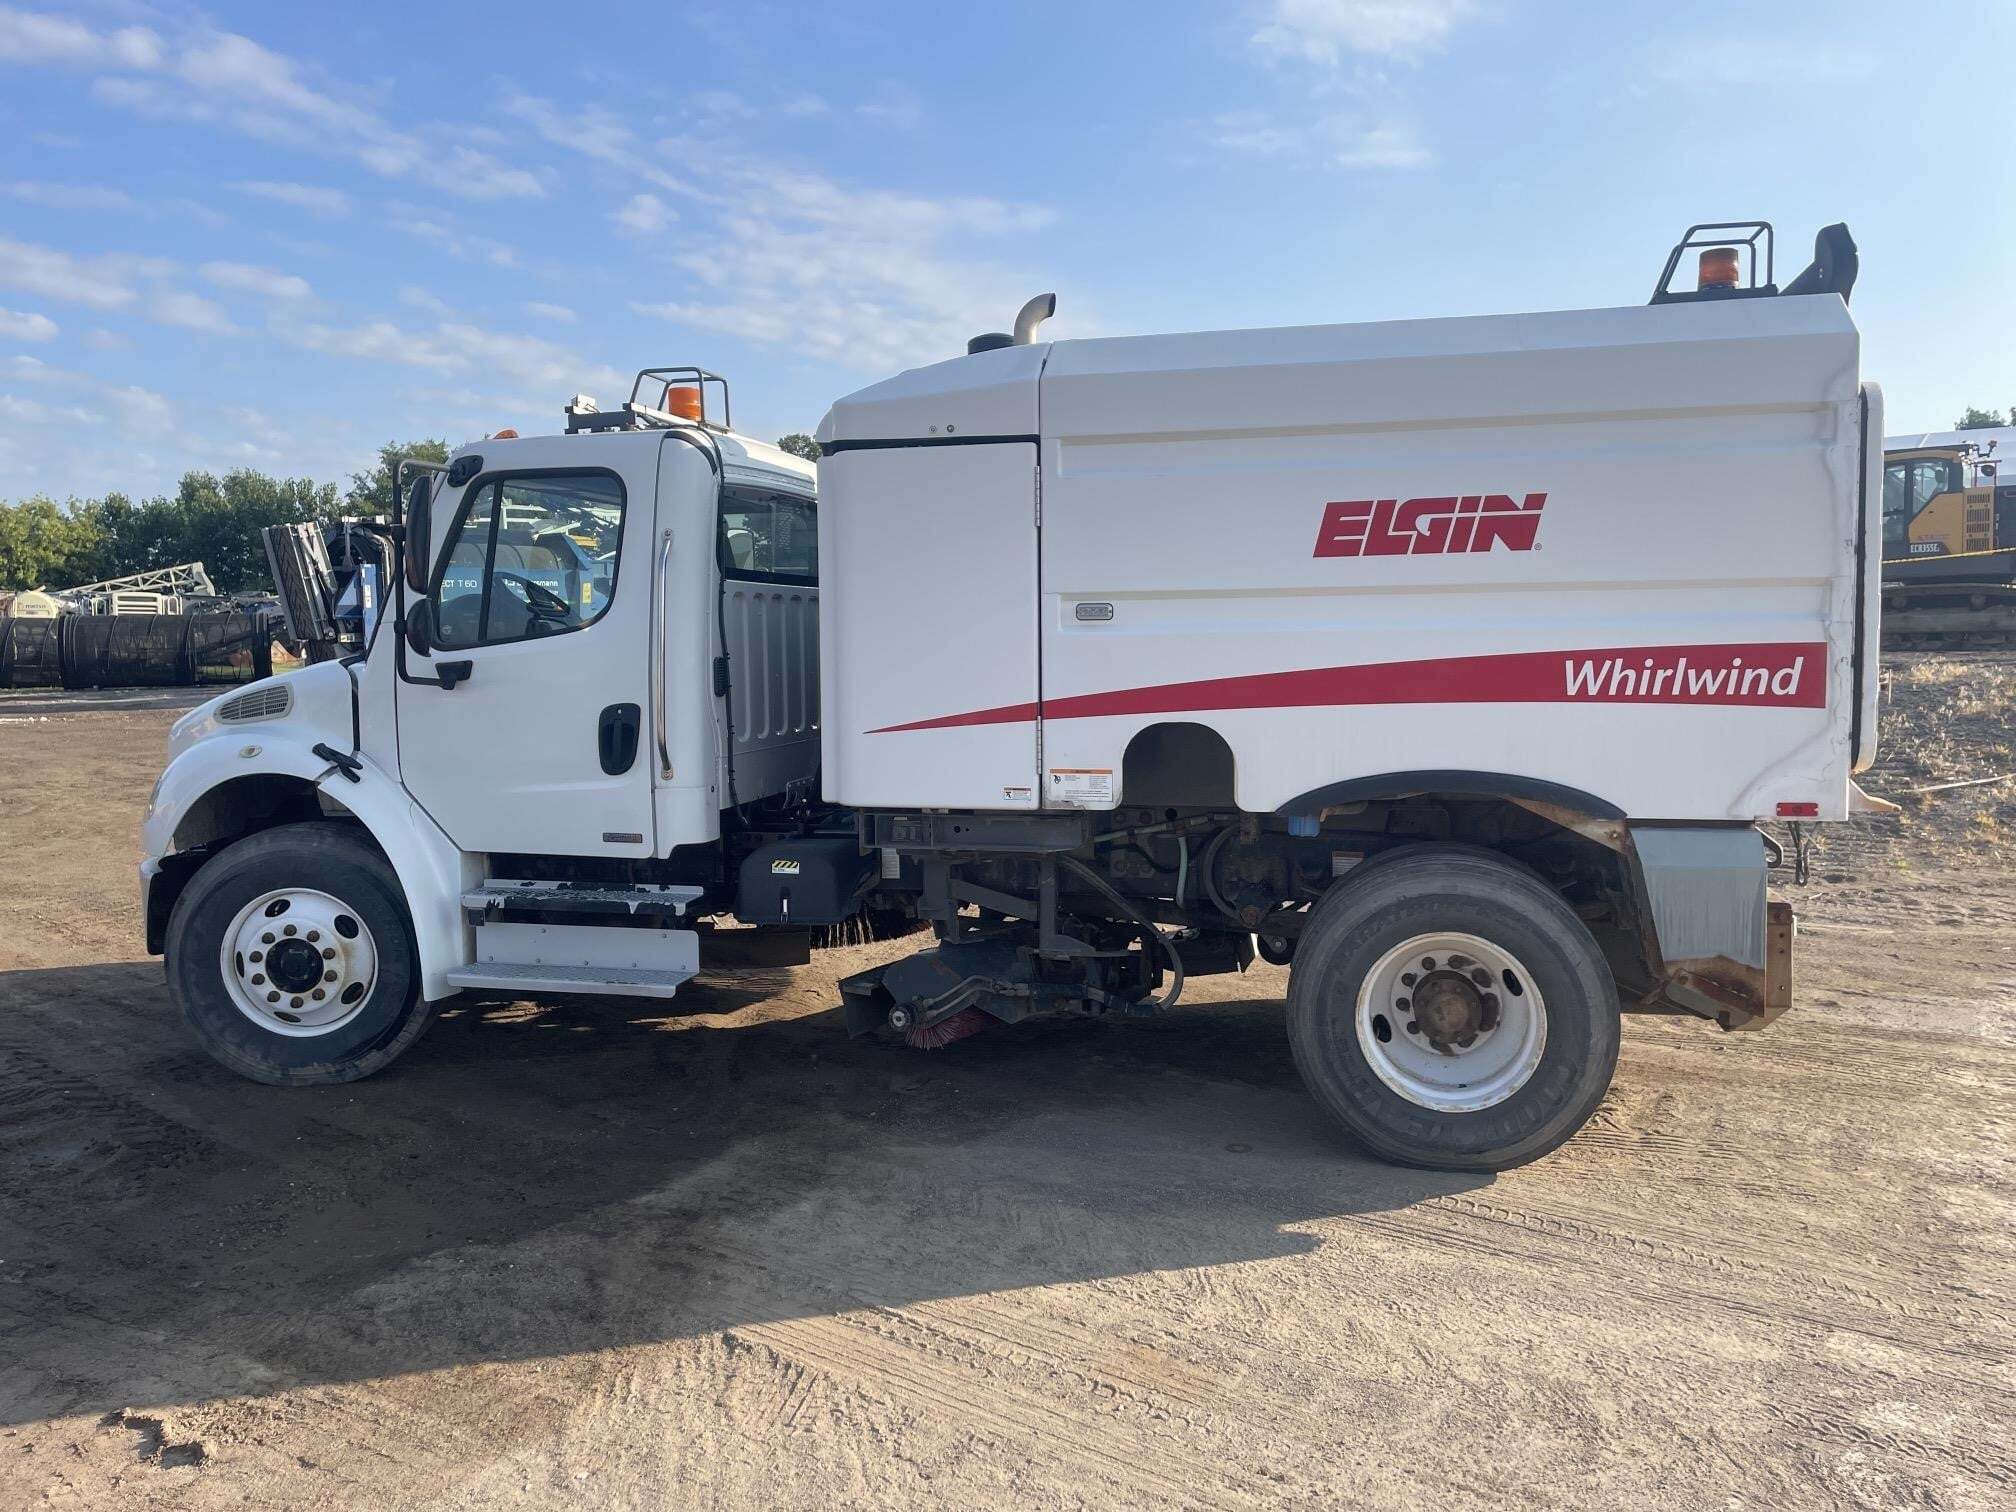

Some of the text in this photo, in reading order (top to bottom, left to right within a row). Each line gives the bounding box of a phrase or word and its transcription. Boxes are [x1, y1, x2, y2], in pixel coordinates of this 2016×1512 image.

[1313, 493, 1547, 557] ELGIN
[457, 579, 464, 588] T
[464, 579, 478, 588] 60
[1565, 656, 1804, 696] Whirlwind
